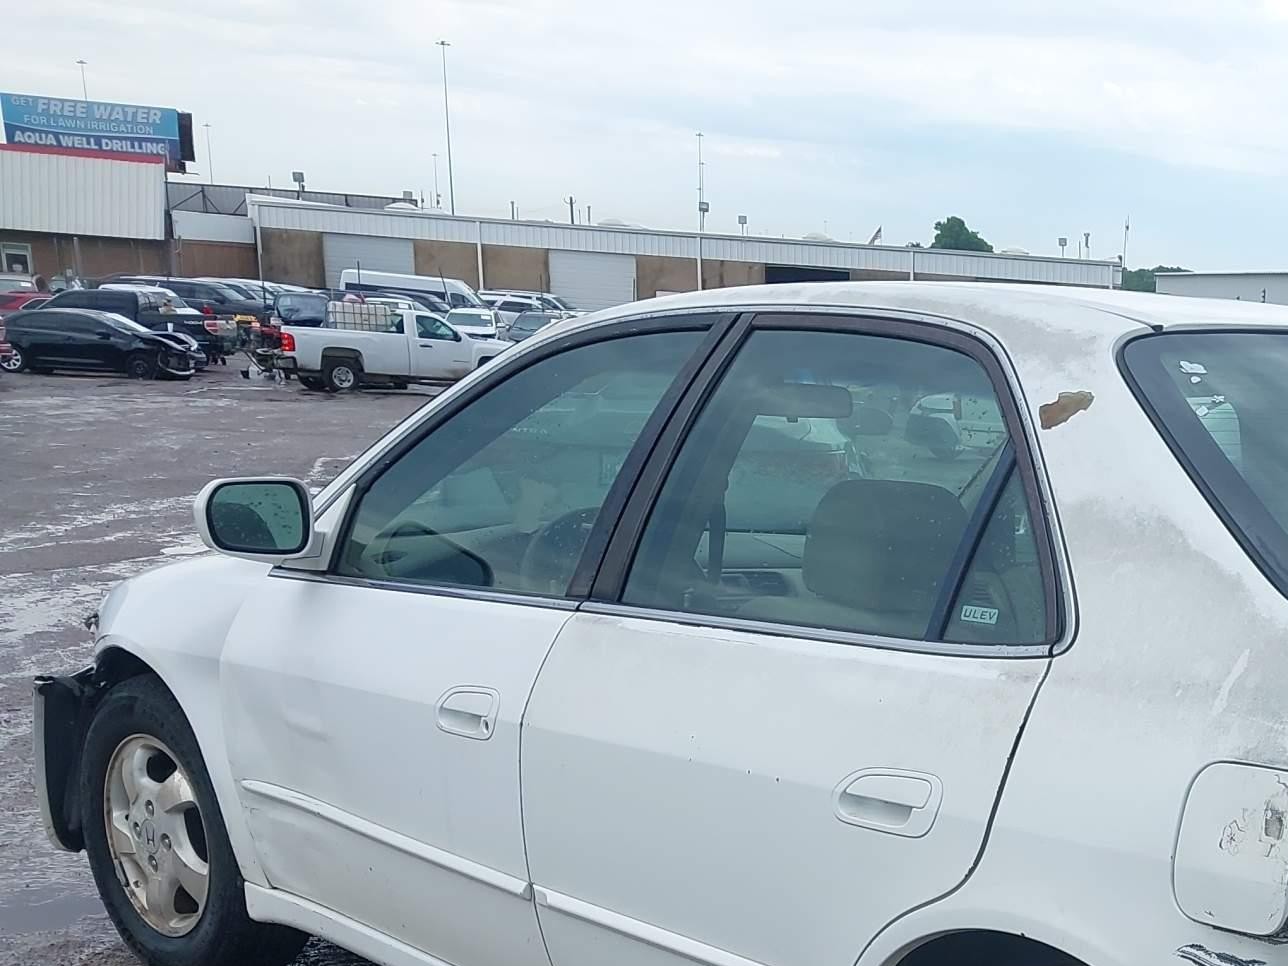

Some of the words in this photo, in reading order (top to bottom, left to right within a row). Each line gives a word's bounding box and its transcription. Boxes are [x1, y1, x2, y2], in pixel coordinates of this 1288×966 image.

[11, 96, 33, 106] GET
[37, 98, 88, 118] FREE
[93, 104, 162, 124] WATER
[23, 114, 47, 125] FOR
[50, 117, 85, 129] LAWN
[87, 121, 153, 135] IRRIGATION
[14, 131, 57, 146] AQUA
[59, 134, 99, 150] WELL
[101, 138, 167, 154] DRILLING
[963, 608, 997, 620] ULEV
